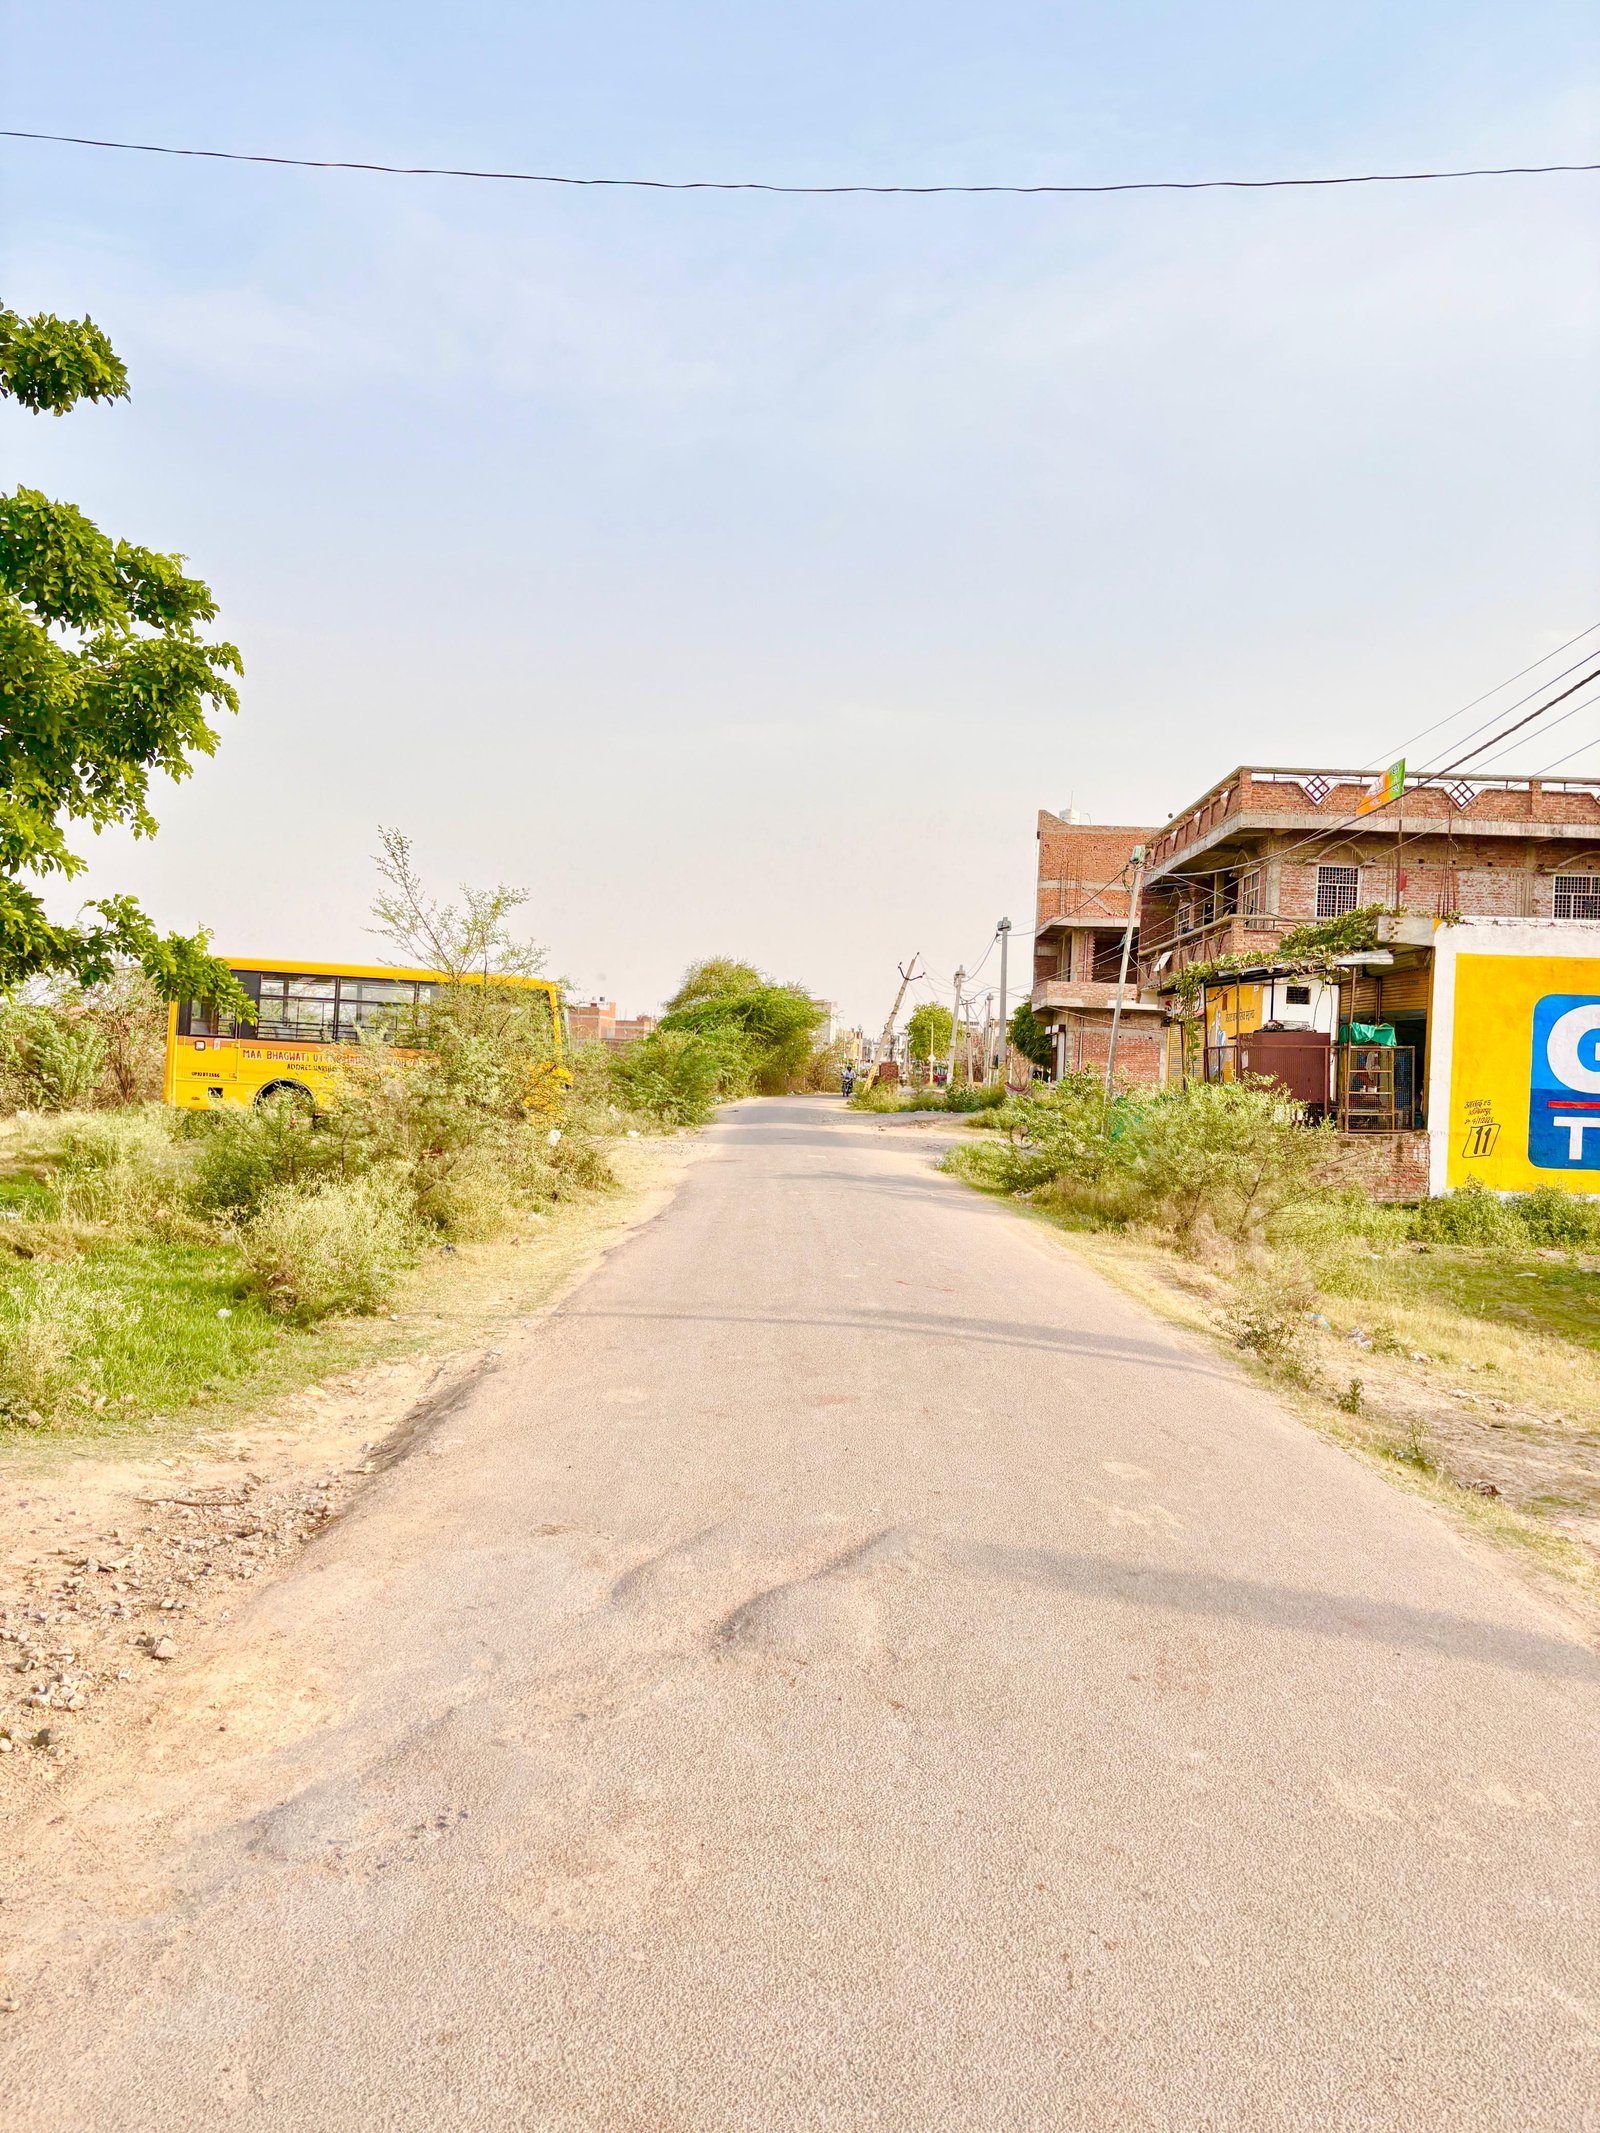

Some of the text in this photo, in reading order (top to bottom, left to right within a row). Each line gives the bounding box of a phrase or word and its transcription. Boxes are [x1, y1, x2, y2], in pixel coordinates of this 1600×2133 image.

[242, 1049, 262, 1059] MAA
[1473, 1126, 1492, 1155] 11
[1553, 1116, 1600, 1160] T
